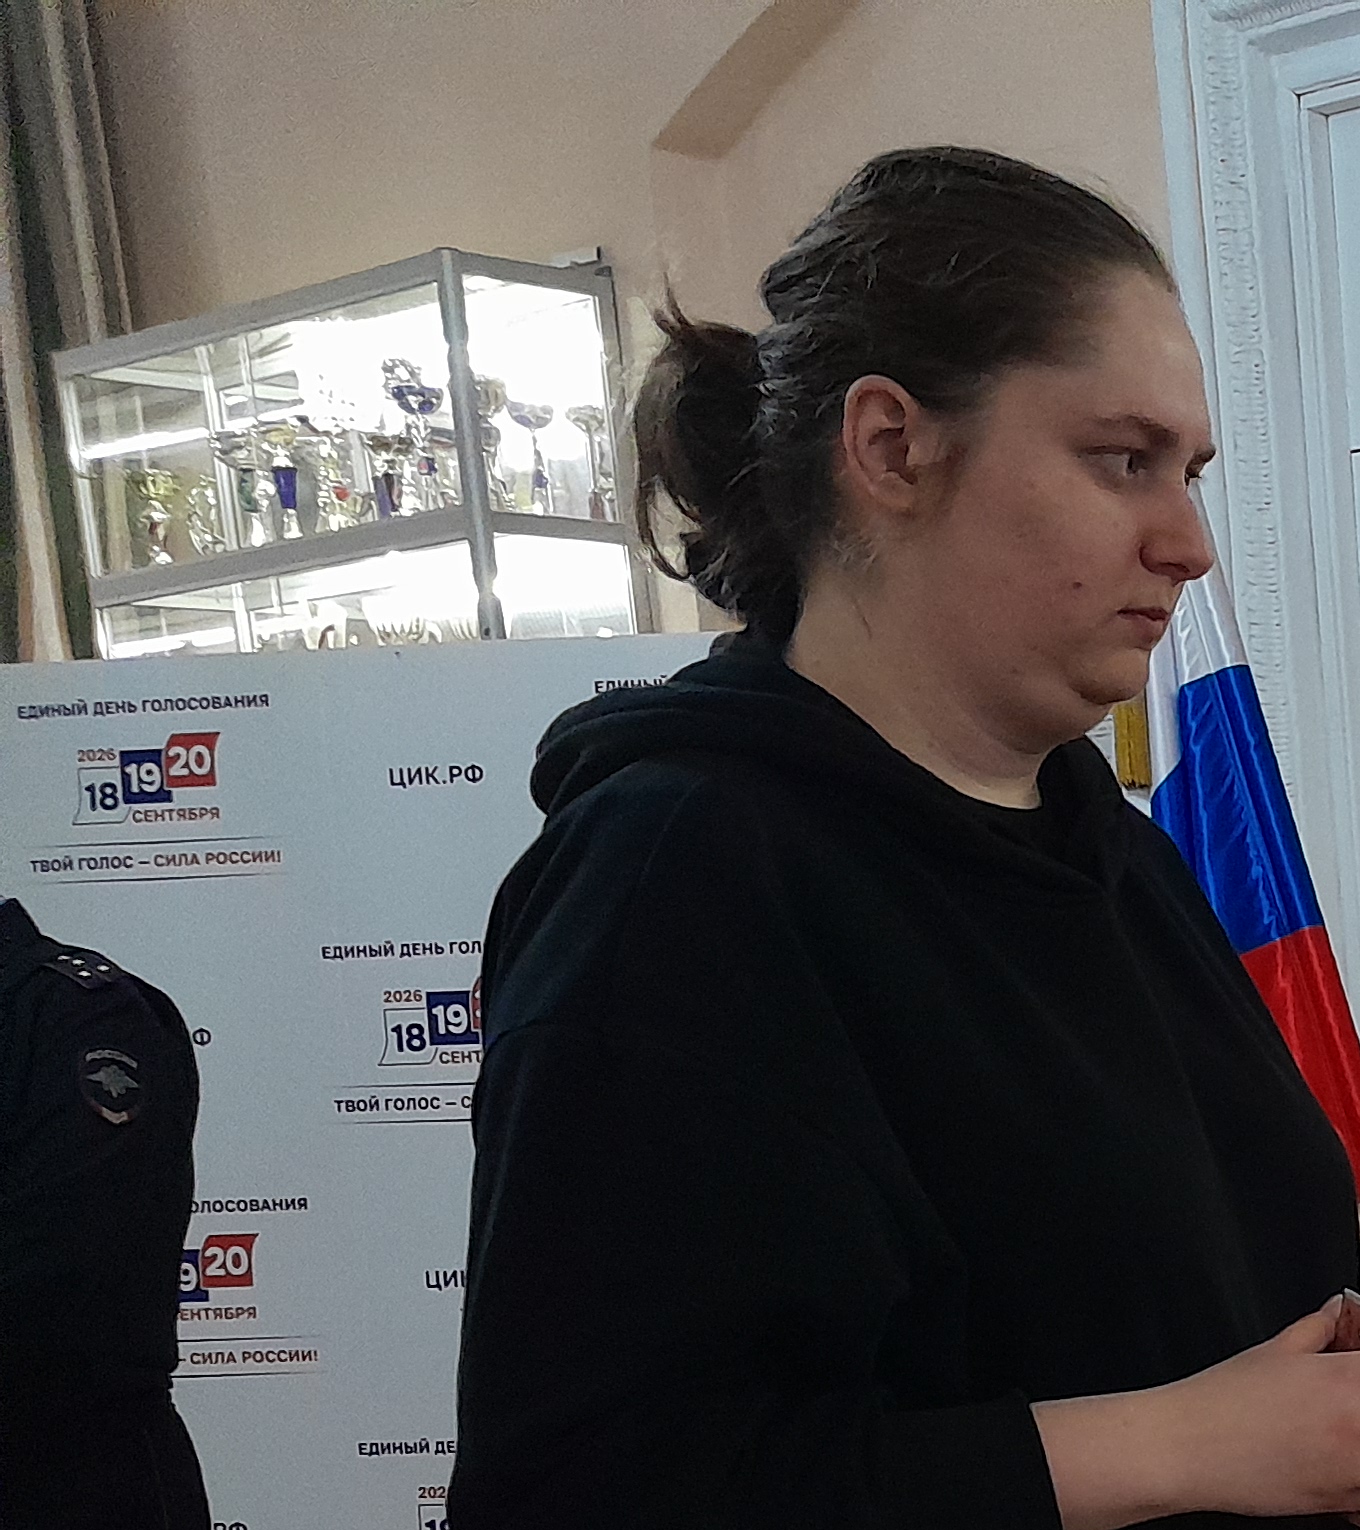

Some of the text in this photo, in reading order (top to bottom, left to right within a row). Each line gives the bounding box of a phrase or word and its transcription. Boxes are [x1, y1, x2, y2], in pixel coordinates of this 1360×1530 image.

[17, 694, 270, 720] ЕДИНЫЙ ДЕНЬ ГОЛОСОВАНИЯ
[77, 748, 117, 762] 2026
[84, 745, 211, 811] 18 19 20
[388, 763, 484, 790] ЦИК.РФ
[132, 806, 221, 823] СЕНТЯБРЯ
[30, 855, 74, 873] ТВОЙ
[78, 855, 134, 871] ГОЛОС
[154, 853, 200, 869] СИЛА
[205, 850, 281, 866] РОССИИ!
[321, 940, 395, 960] ЕДИНЫЙ
[399, 942, 445, 958] ДЕНЬ
[383, 990, 422, 1003] 2026
[391, 1023, 427, 1052] 18
[431, 1004, 469, 1035] 19
[439, 1050, 482, 1064] СЕНТ
[334, 1095, 380, 1112] ТВОЙ
[385, 1097, 440, 1111] ГОЛОС
[191, 1197, 308, 1214] ОЛОСОВАНИЯ
[180, 1246, 249, 1291] 9 20
[178, 1306, 257, 1321] ЕНТЯБРЯ
[190, 1351, 237, 1365] СИЛА
[242, 1350, 318, 1364] РОССИИ!
[358, 1438, 456, 1456] ЕДИНЫЙ ДЕ
[418, 1486, 446, 1499] 202
